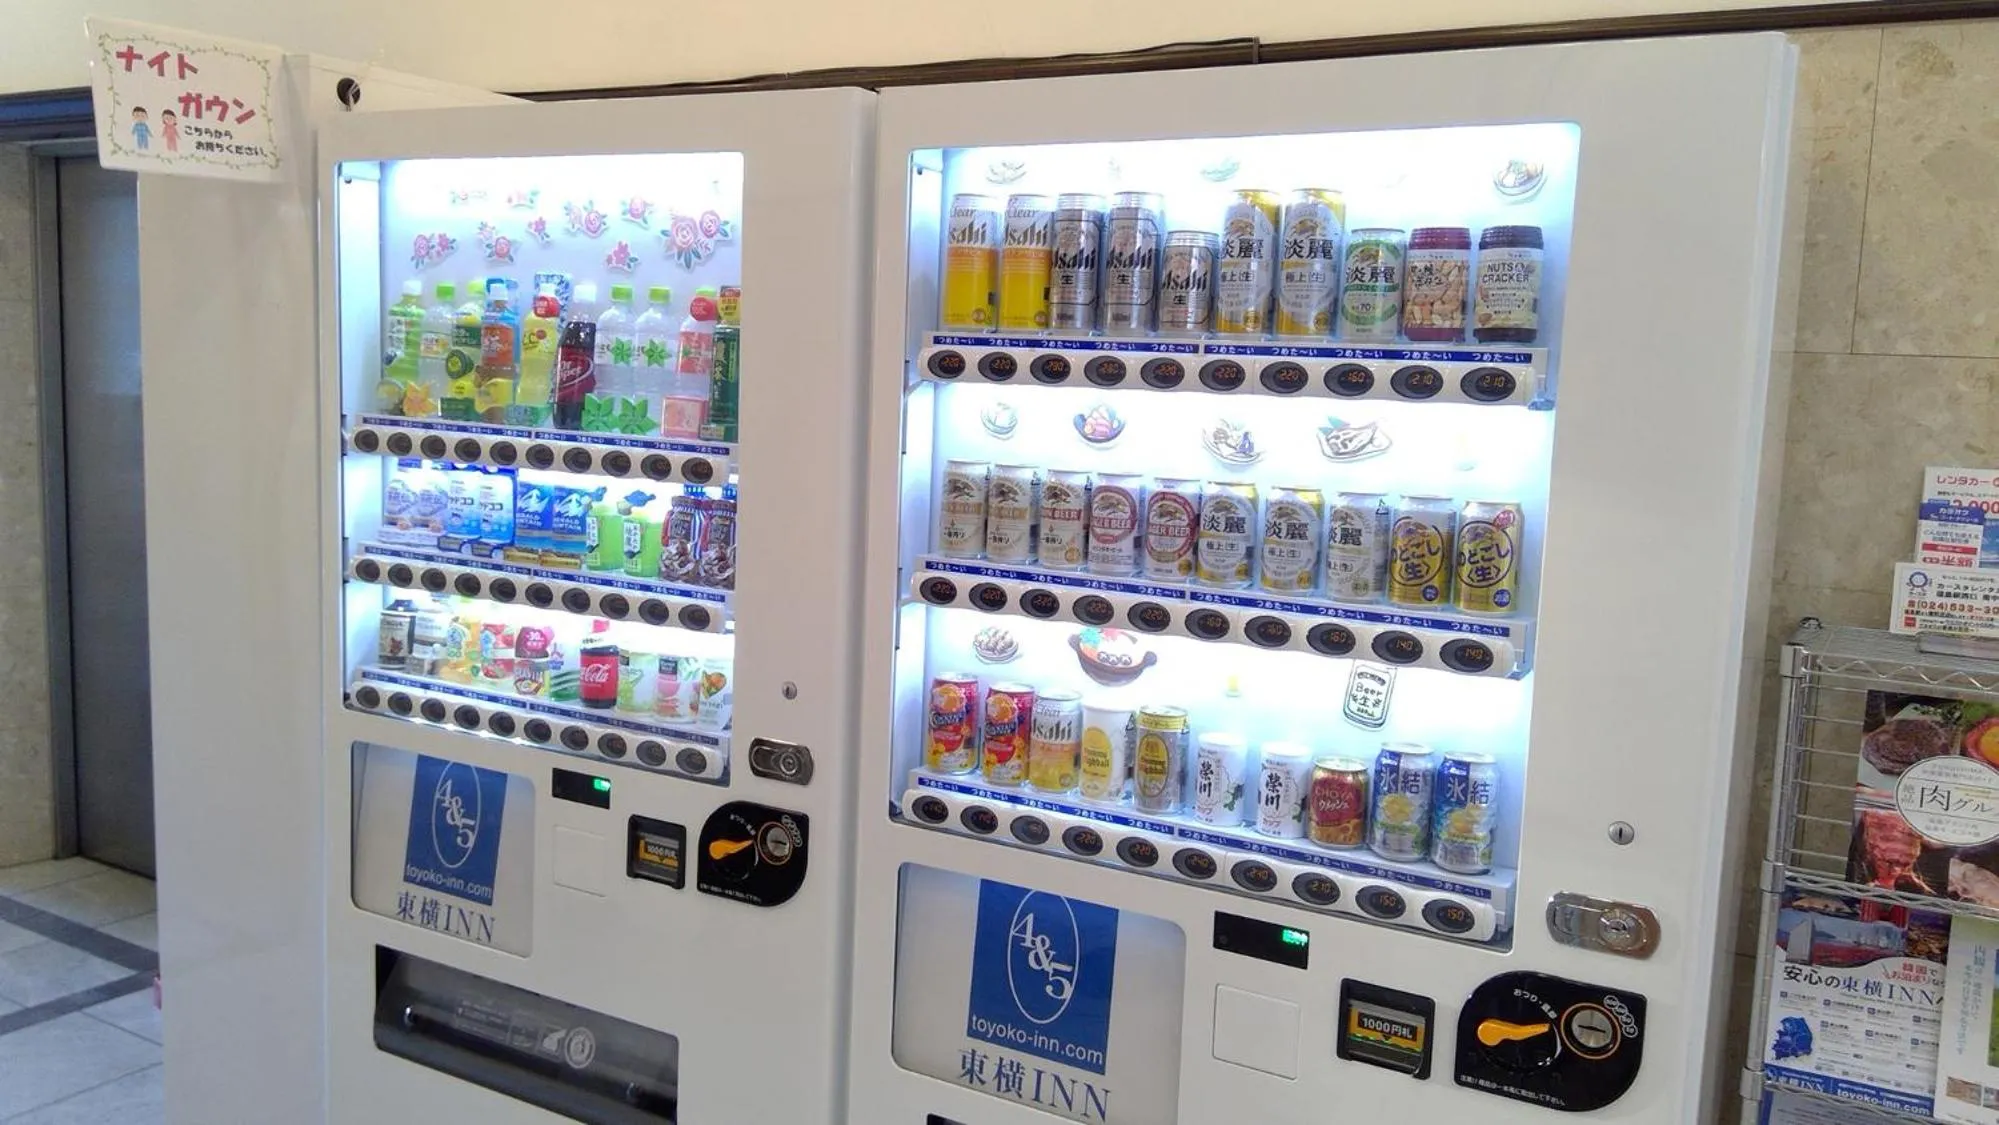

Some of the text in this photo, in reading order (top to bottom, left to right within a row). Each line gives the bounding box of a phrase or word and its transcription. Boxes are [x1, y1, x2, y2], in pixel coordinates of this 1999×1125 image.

[116, 45, 198, 80] ナイト
[178, 92, 255, 124] ガウン
[184, 125, 233, 139] こちらから
[949, 220, 987, 246] sahi
[1284, 238, 1333, 259] 淡麗
[1162, 270, 1208, 291] Asahi
[1481, 273, 1529, 285] CRACKER
[1937, 475, 1990, 486] レンタカー
[1203, 514, 1246, 534] 淡麗
[1265, 520, 1310, 540] 淡麗
[1355, 682, 1383, 696] Beer
[1380, 767, 1422, 795] 氷結
[1446, 776, 1491, 806] 氷結
[406, 864, 493, 899] toyoko-inn.com
[396, 891, 496, 943] 東横INN
[1012, 912, 1073, 1000] 4&5
[971, 1015, 1104, 1065] toyoko-inn.com
[958, 1048, 1111, 1123] 東横INN
